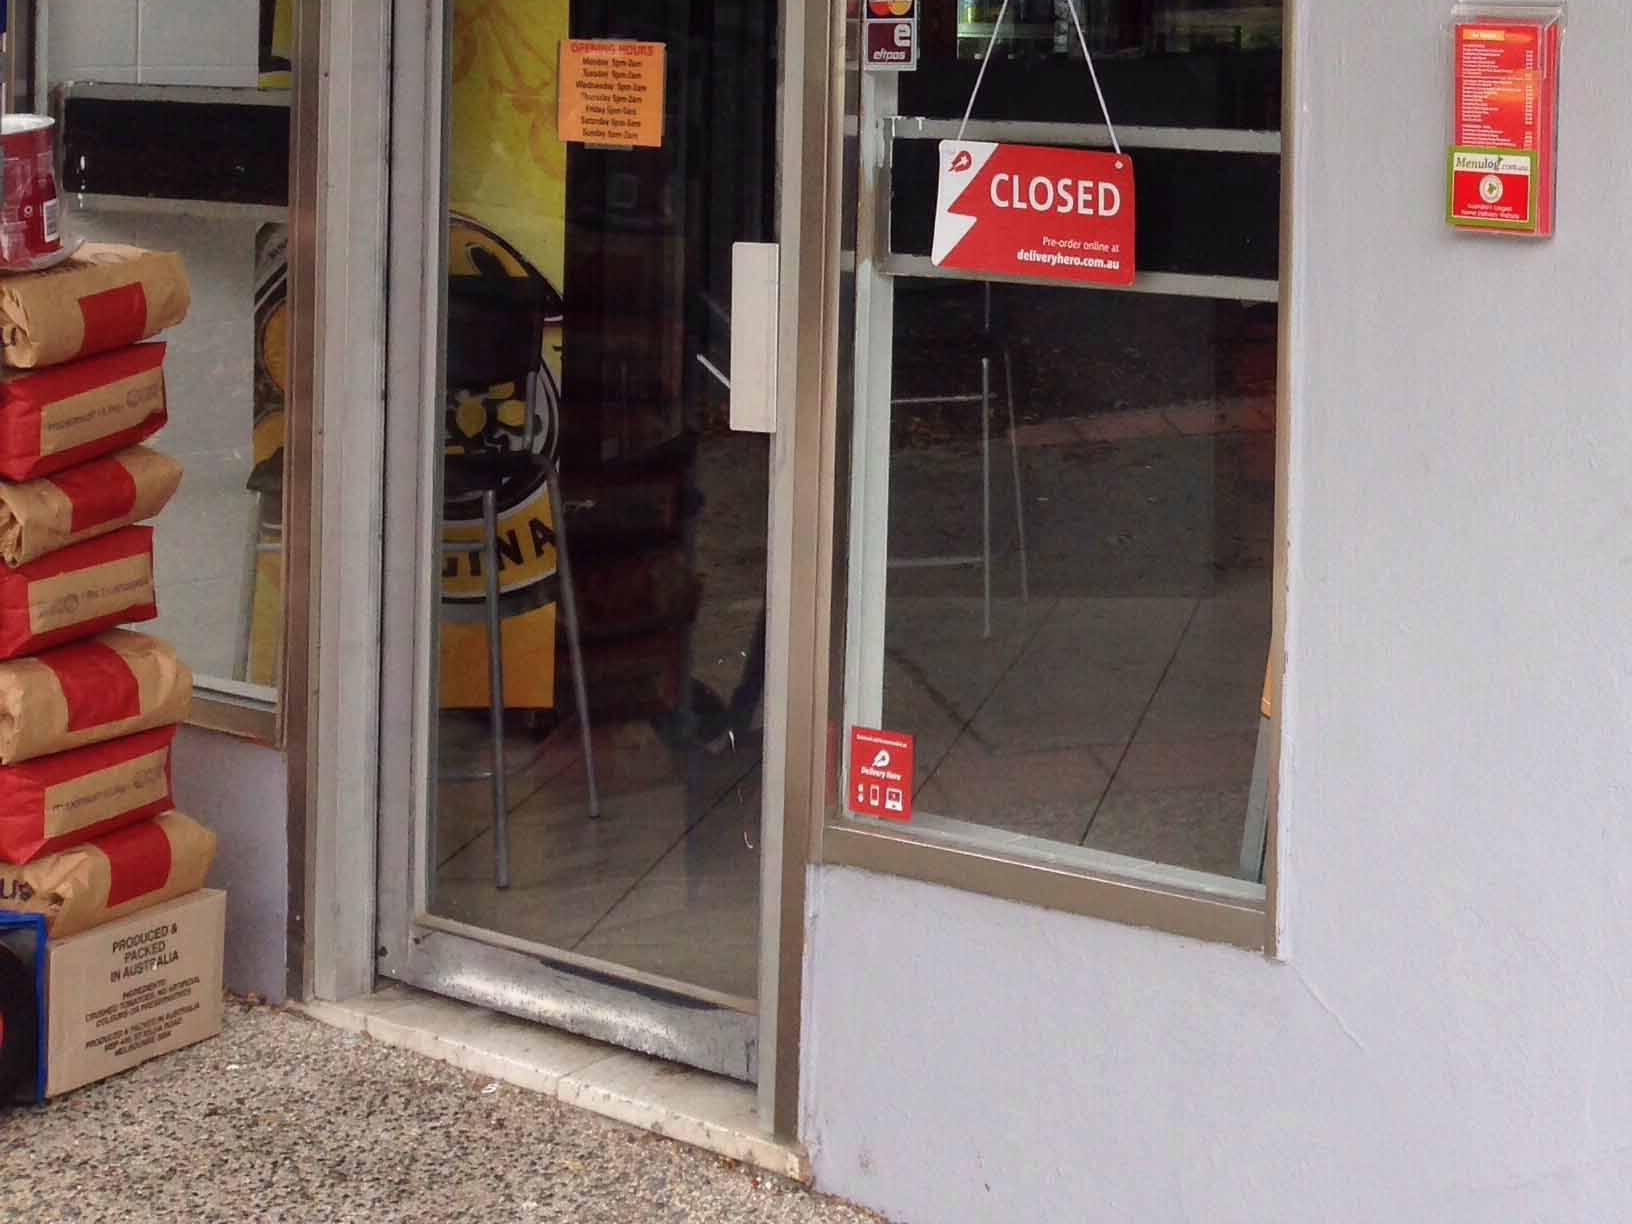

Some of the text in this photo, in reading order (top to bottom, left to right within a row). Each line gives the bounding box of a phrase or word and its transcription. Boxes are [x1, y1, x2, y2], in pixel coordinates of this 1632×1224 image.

[990, 173, 1121, 217] CLOSED
[1042, 236, 1120, 253] Pre-order online at
[1017, 249, 1120, 270] deliveryhero.com.au
[113, 925, 168, 953] PRODUCED
[124, 940, 166, 963] PACKED
[122, 950, 179, 979] AUSTRALIA
